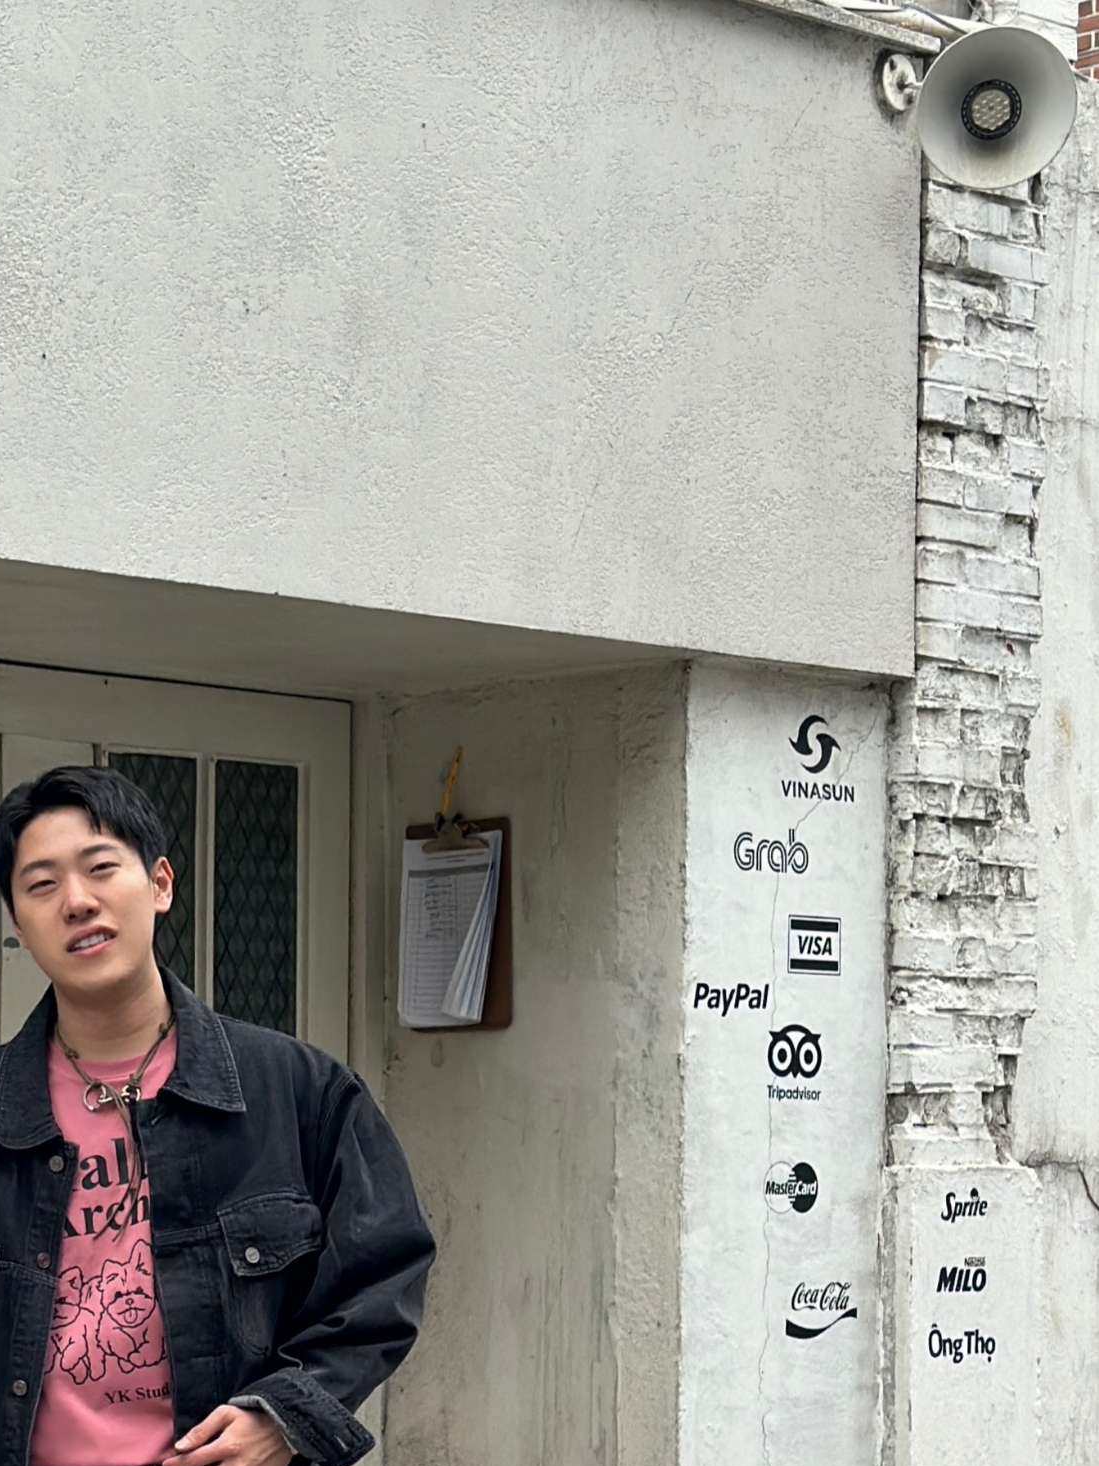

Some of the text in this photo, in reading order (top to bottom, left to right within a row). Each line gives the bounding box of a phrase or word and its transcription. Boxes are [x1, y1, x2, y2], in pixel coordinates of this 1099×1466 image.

[781, 780, 854, 802] VINASUN
[734, 829, 809, 874] Grab
[796, 935, 833, 956] VISA
[693, 983, 769, 1017] PayPal
[767, 1085, 821, 1102] Tripadvisor
[765, 1180, 817, 1195] MasterCard
[941, 1187, 988, 1224] Sprite
[936, 1266, 987, 1293] MILO
[928, 1323, 996, 1364] Ông Thọ
[105, 1390, 133, 1404] YK
